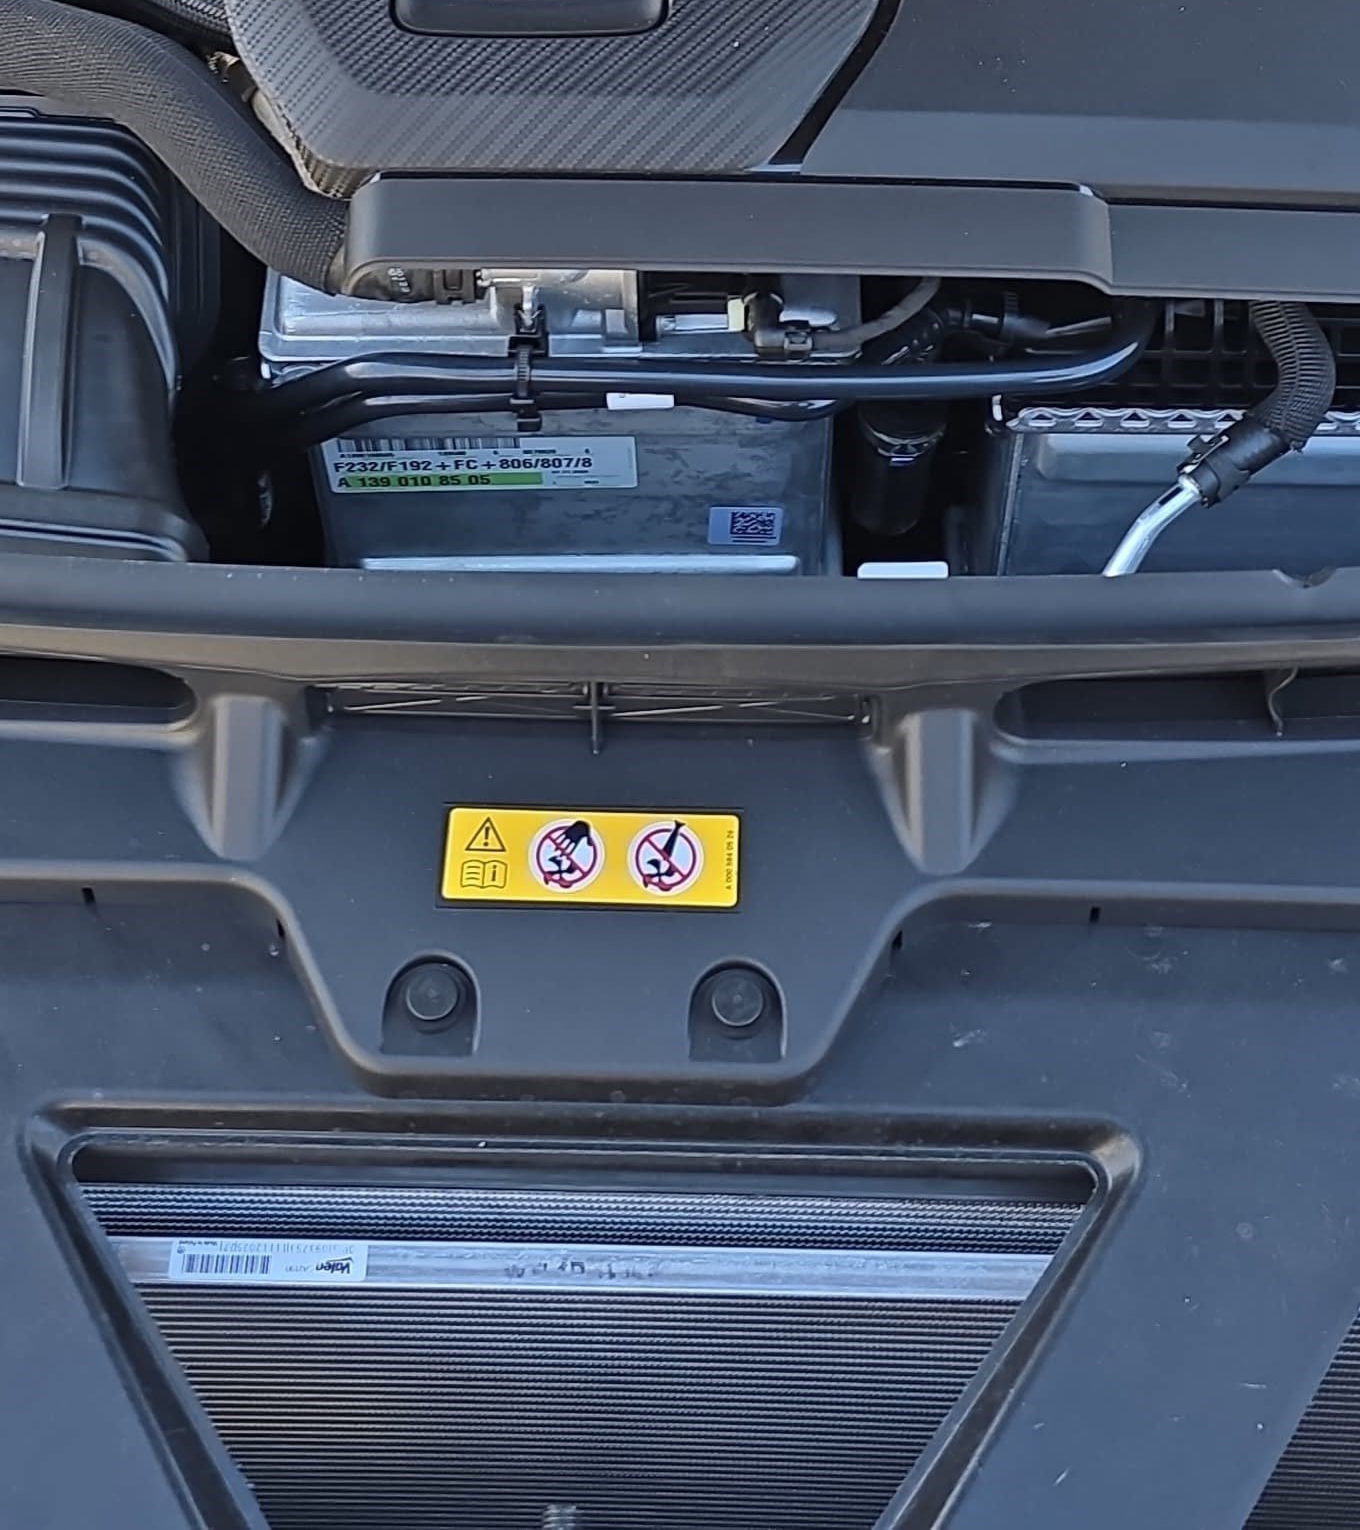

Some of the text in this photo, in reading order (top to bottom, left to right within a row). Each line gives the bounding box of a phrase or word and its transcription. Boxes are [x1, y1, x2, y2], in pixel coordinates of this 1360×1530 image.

[334, 460, 433, 473] F232/F192
[453, 459, 478, 470] FC
[499, 457, 593, 470] 806/807/8
[337, 474, 491, 488] A 139 010 85 05
